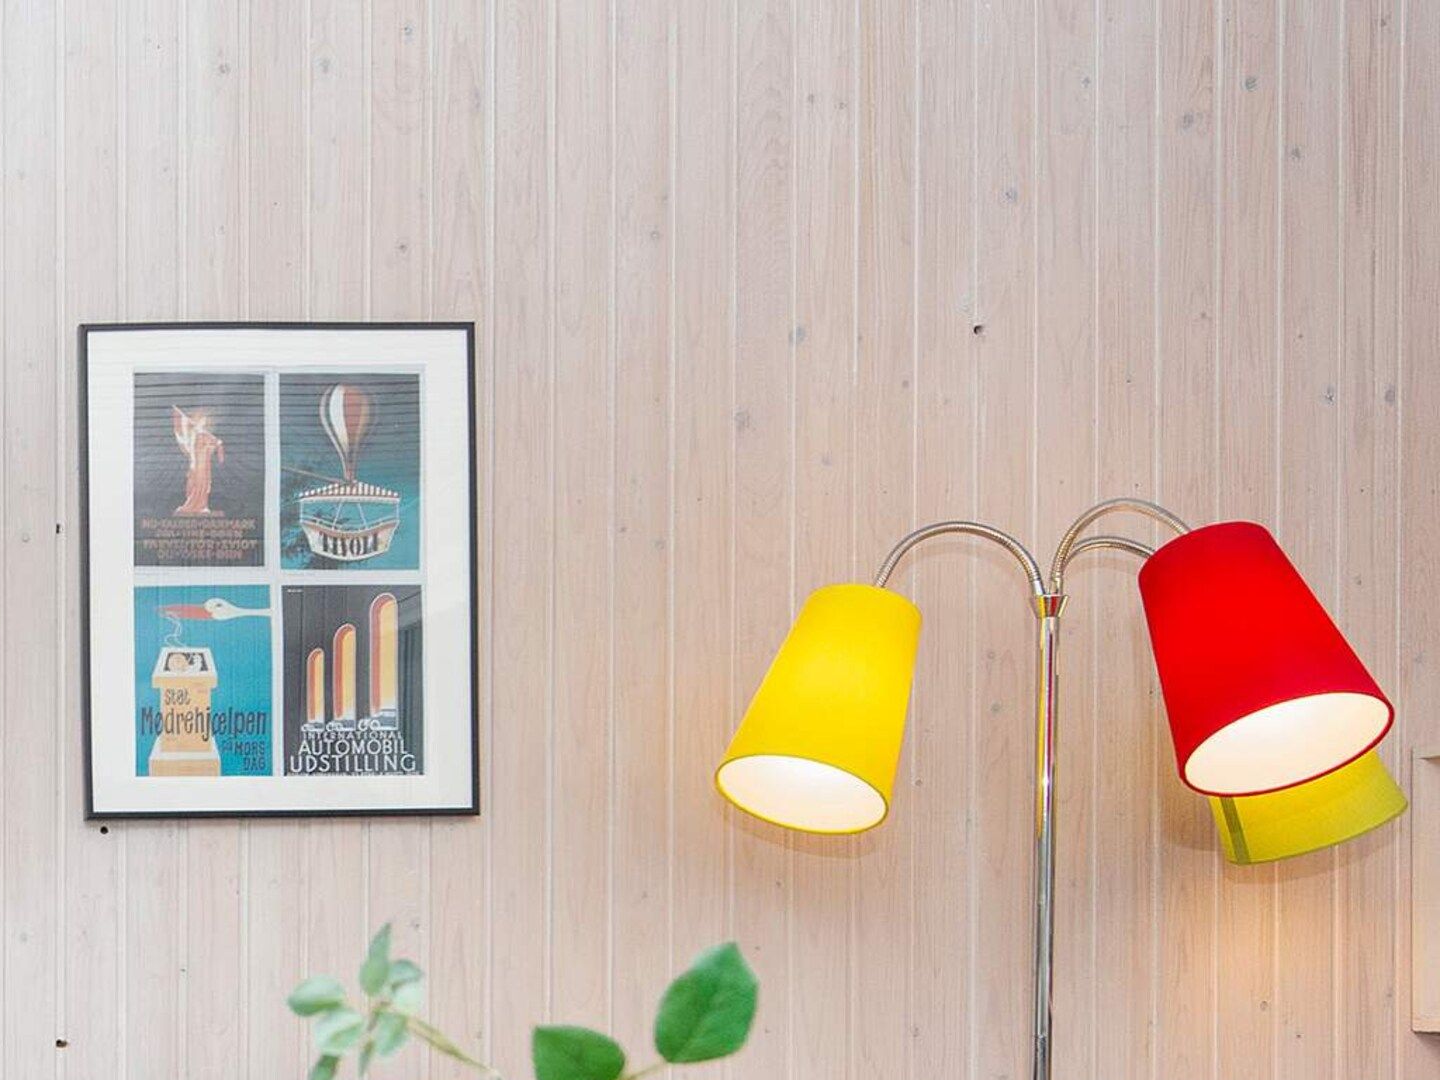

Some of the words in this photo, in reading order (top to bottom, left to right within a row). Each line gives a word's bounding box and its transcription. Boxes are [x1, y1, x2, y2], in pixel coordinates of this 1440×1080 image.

[319, 531, 378, 556] TIVOLI
[141, 707, 266, 741] Mødrehjælpen
[303, 731, 403, 740] INTERNATIONAL
[235, 741, 265, 755] MORS
[298, 739, 408, 755] AUTOMOBIL
[244, 757, 265, 770] DAG
[290, 754, 417, 773] UDSTILLING
